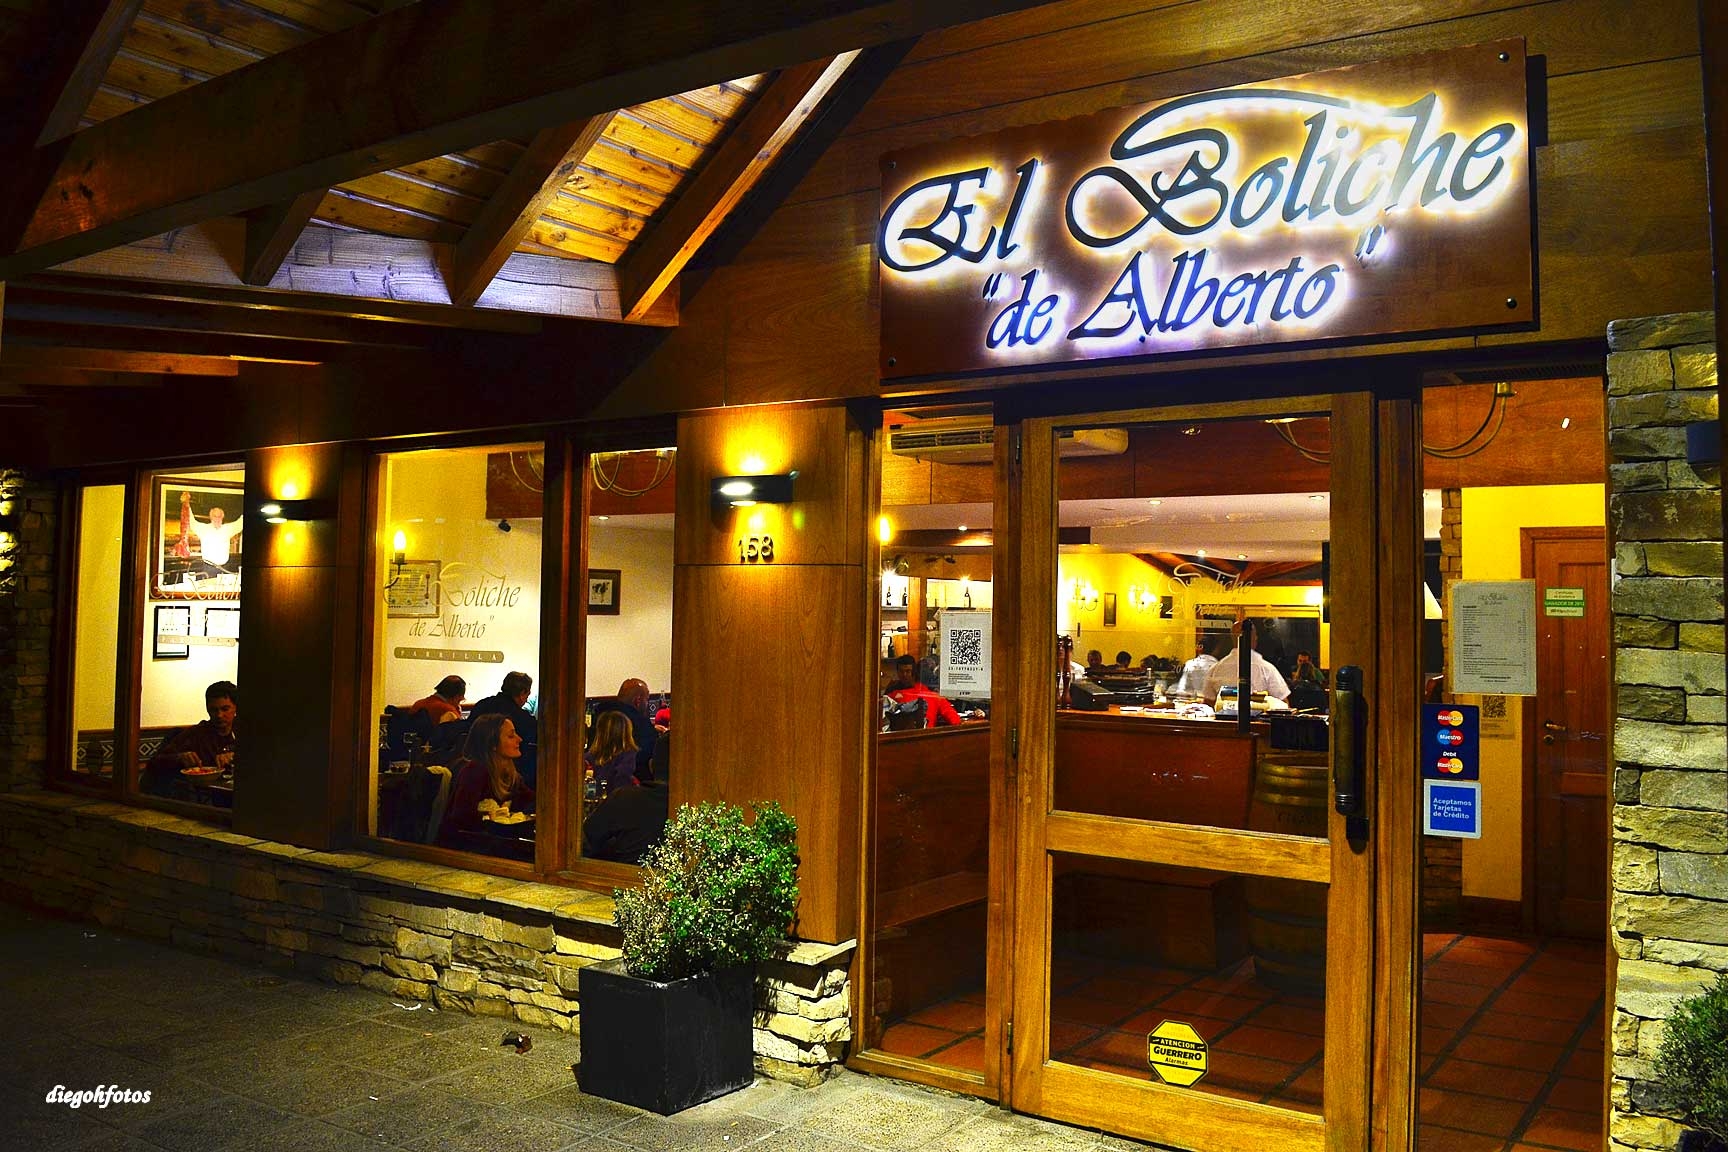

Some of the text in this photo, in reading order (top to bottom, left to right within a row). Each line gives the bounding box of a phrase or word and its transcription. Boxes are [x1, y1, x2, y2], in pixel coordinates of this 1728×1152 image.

[878, 88, 1516, 272] El Boliche
[739, 536, 774, 563] 158
[400, 650, 497, 661] PARRILLA
[1433, 797, 1472, 807] Aceptamos
[1432, 804, 1462, 812] Tarjetas
[1443, 811, 1470, 819] Crédito
[1160, 1038, 1196, 1050] ATENCION
[1153, 1046, 1202, 1061] GUERRERO
[1164, 1057, 1189, 1066] Alarmas
